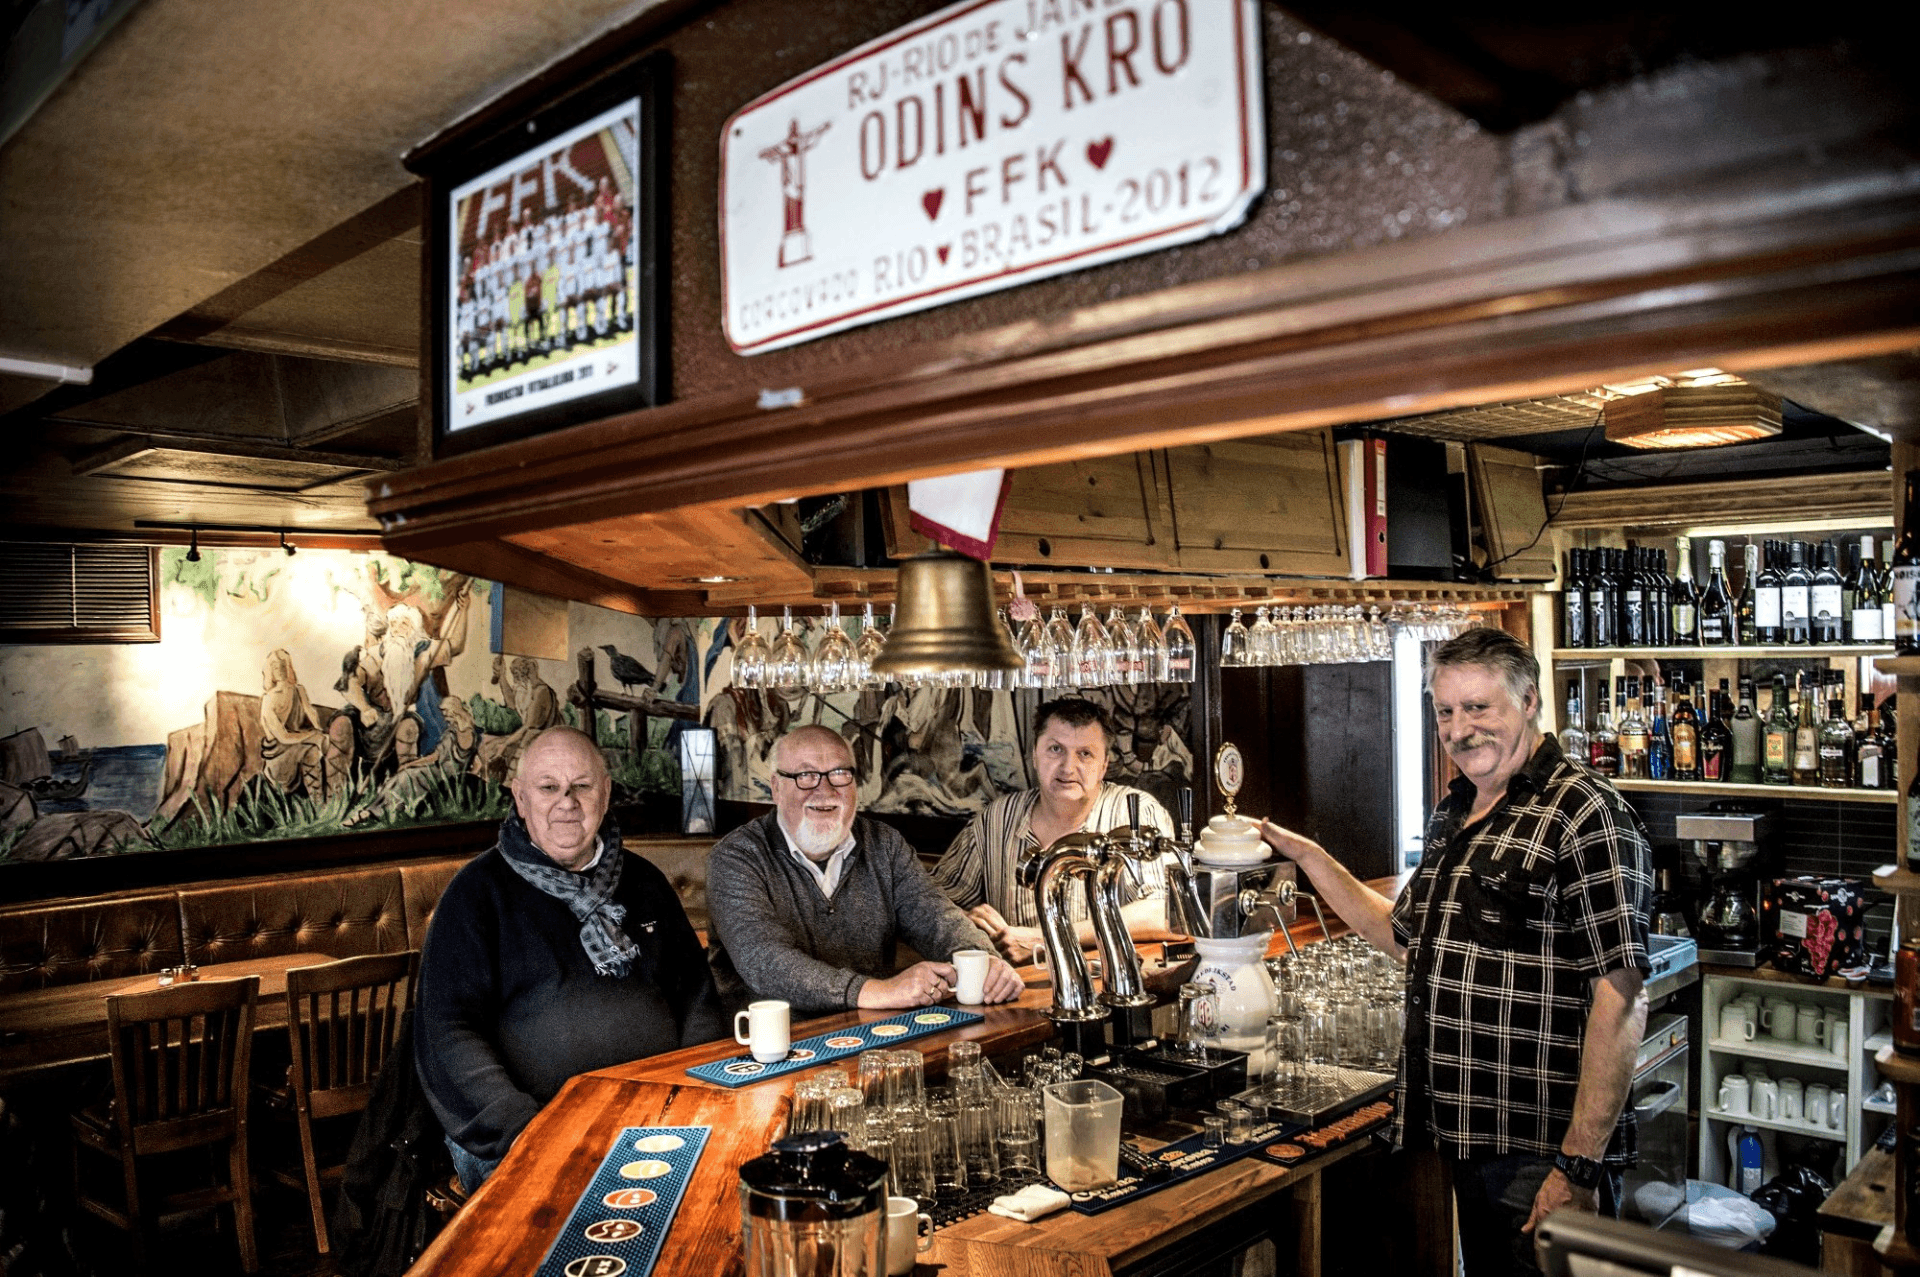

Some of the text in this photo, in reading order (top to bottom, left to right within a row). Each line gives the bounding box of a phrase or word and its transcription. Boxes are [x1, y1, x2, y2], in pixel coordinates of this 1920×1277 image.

[847, 33, 960, 110] RJ-RIO
[966, 29, 1003, 66] DE
[859, 0, 1192, 182] ODINS KRO
[475, 146, 596, 239] FFK
[963, 139, 1070, 217] FFK
[872, 245, 929, 296] RIO
[960, 156, 1222, 270] BRASIL-2012
